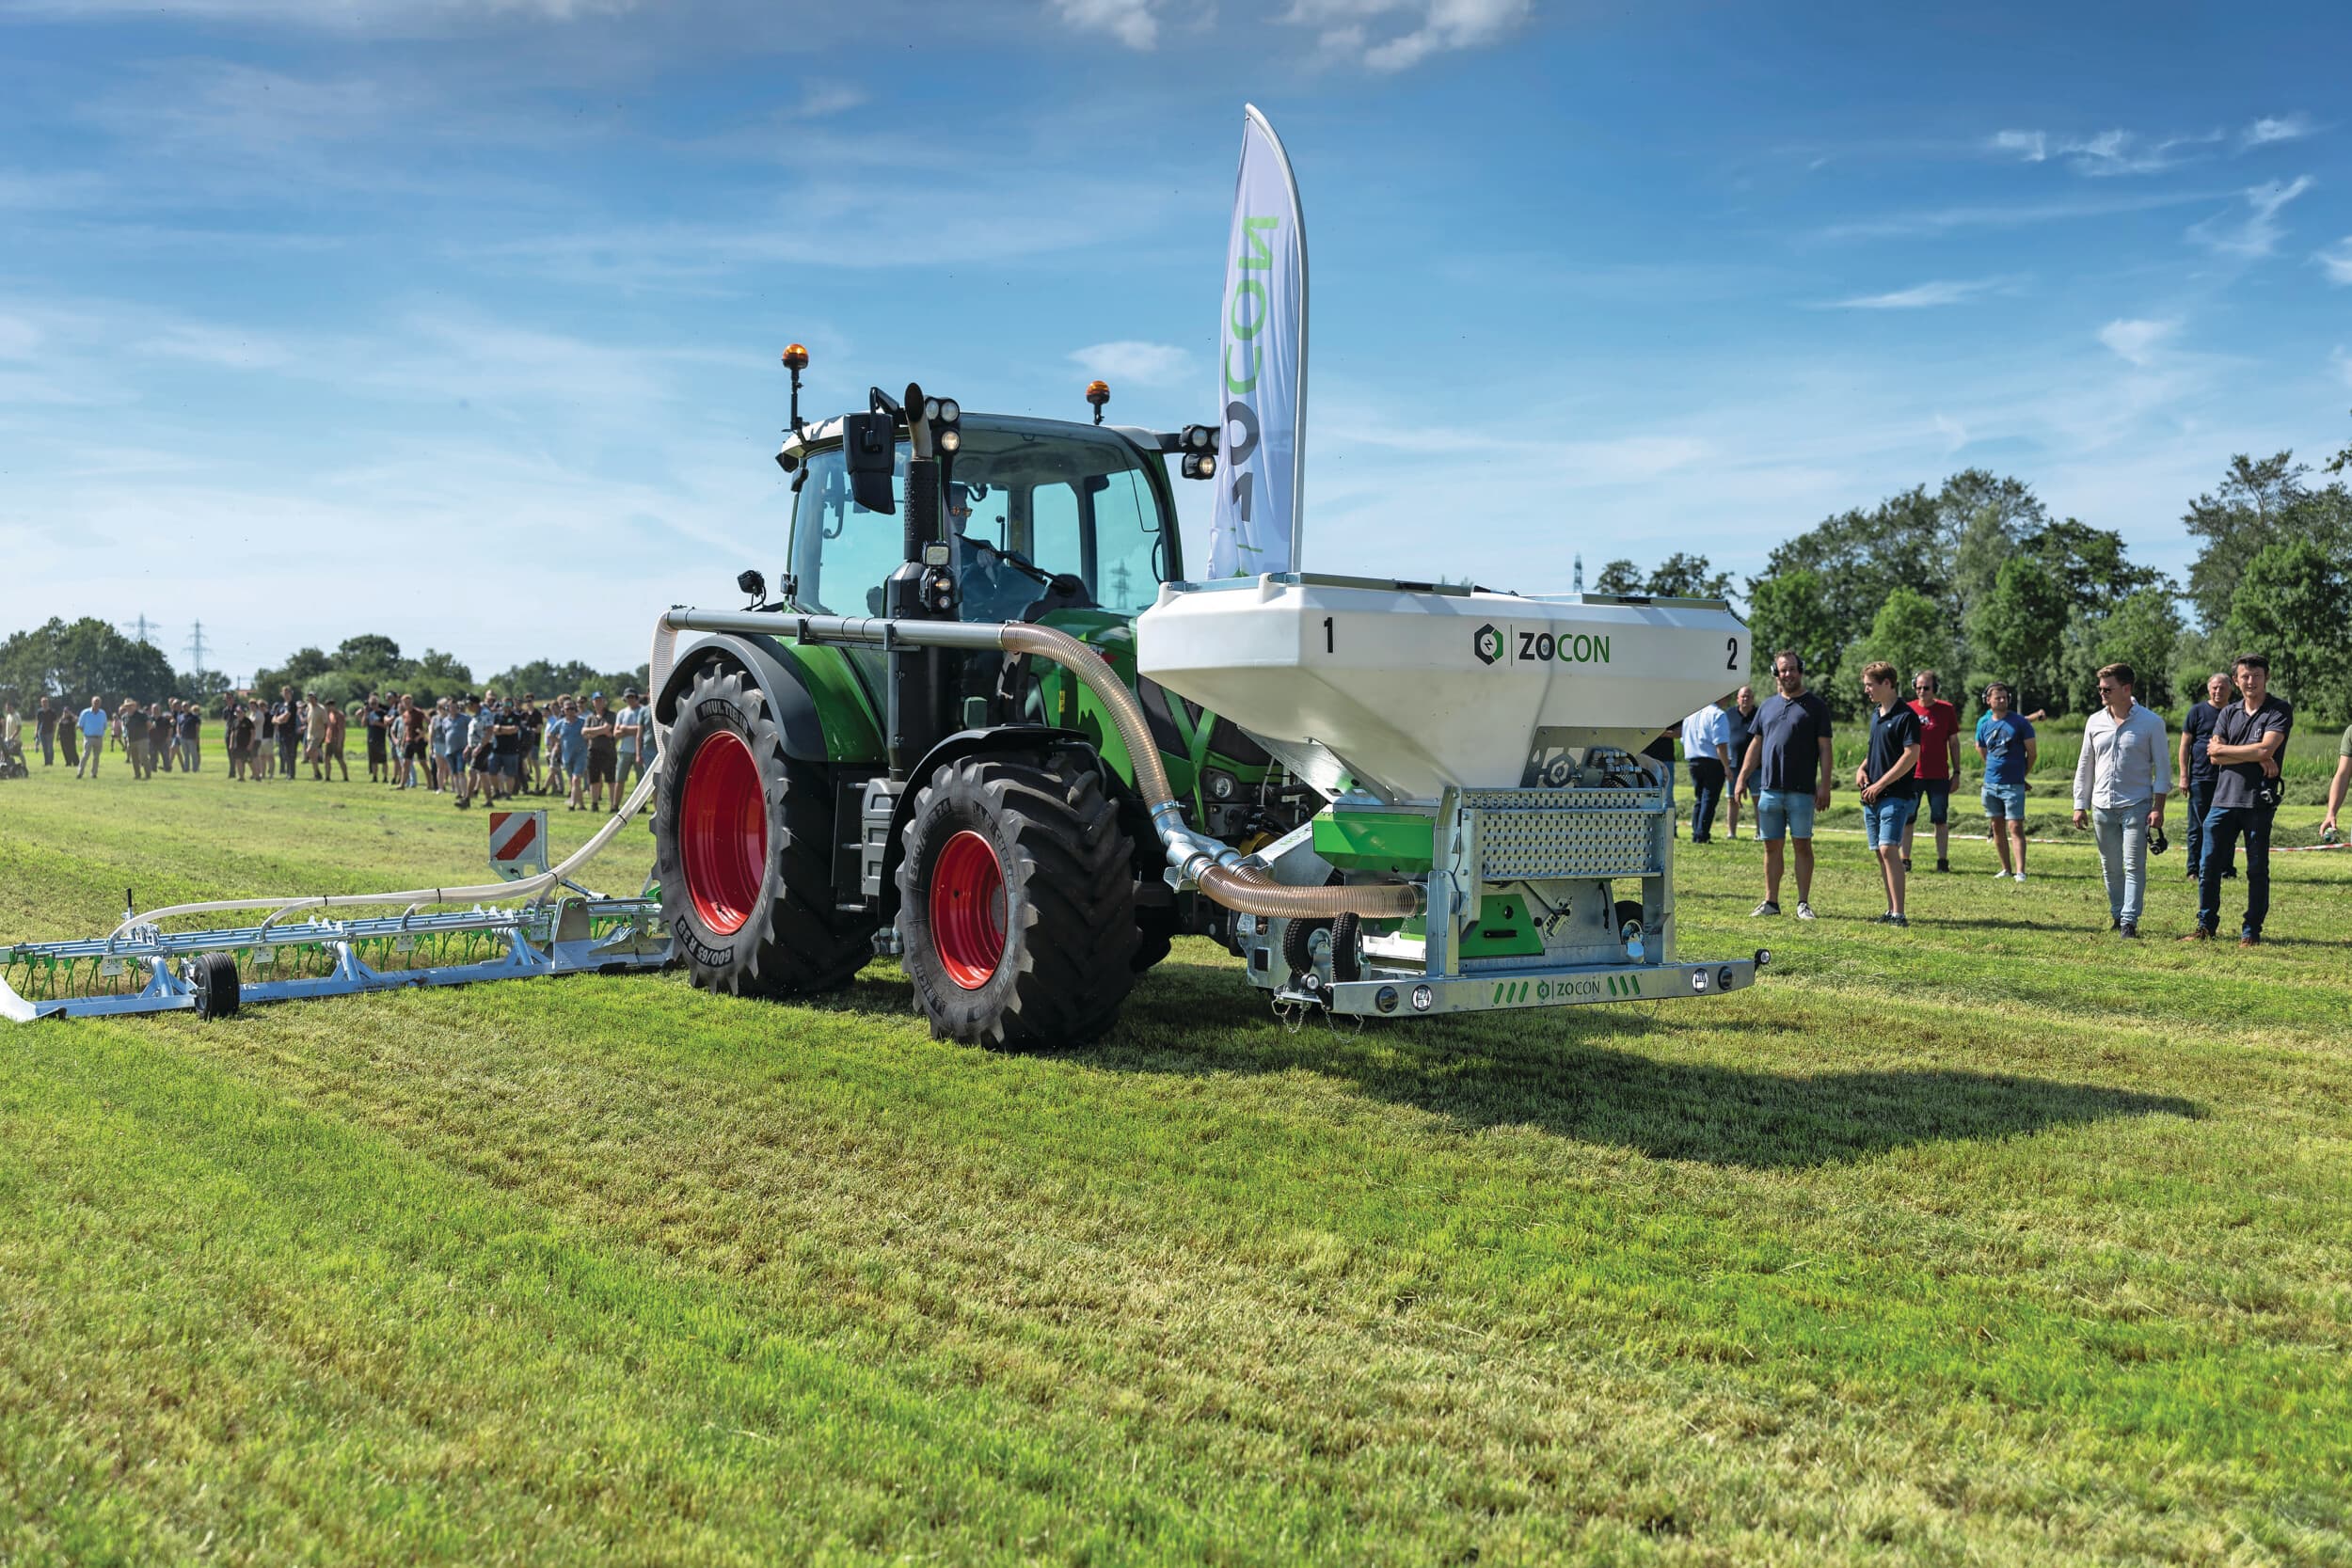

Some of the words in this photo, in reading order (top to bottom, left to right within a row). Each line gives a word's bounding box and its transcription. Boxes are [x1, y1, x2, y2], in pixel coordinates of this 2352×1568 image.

[1324, 616, 1334, 653] 1
[1518, 632, 1610, 663] ZOCON
[1726, 637, 1738, 670] 2
[696, 946, 732, 965] 600/65
[1557, 980, 1600, 996] ZOCON
